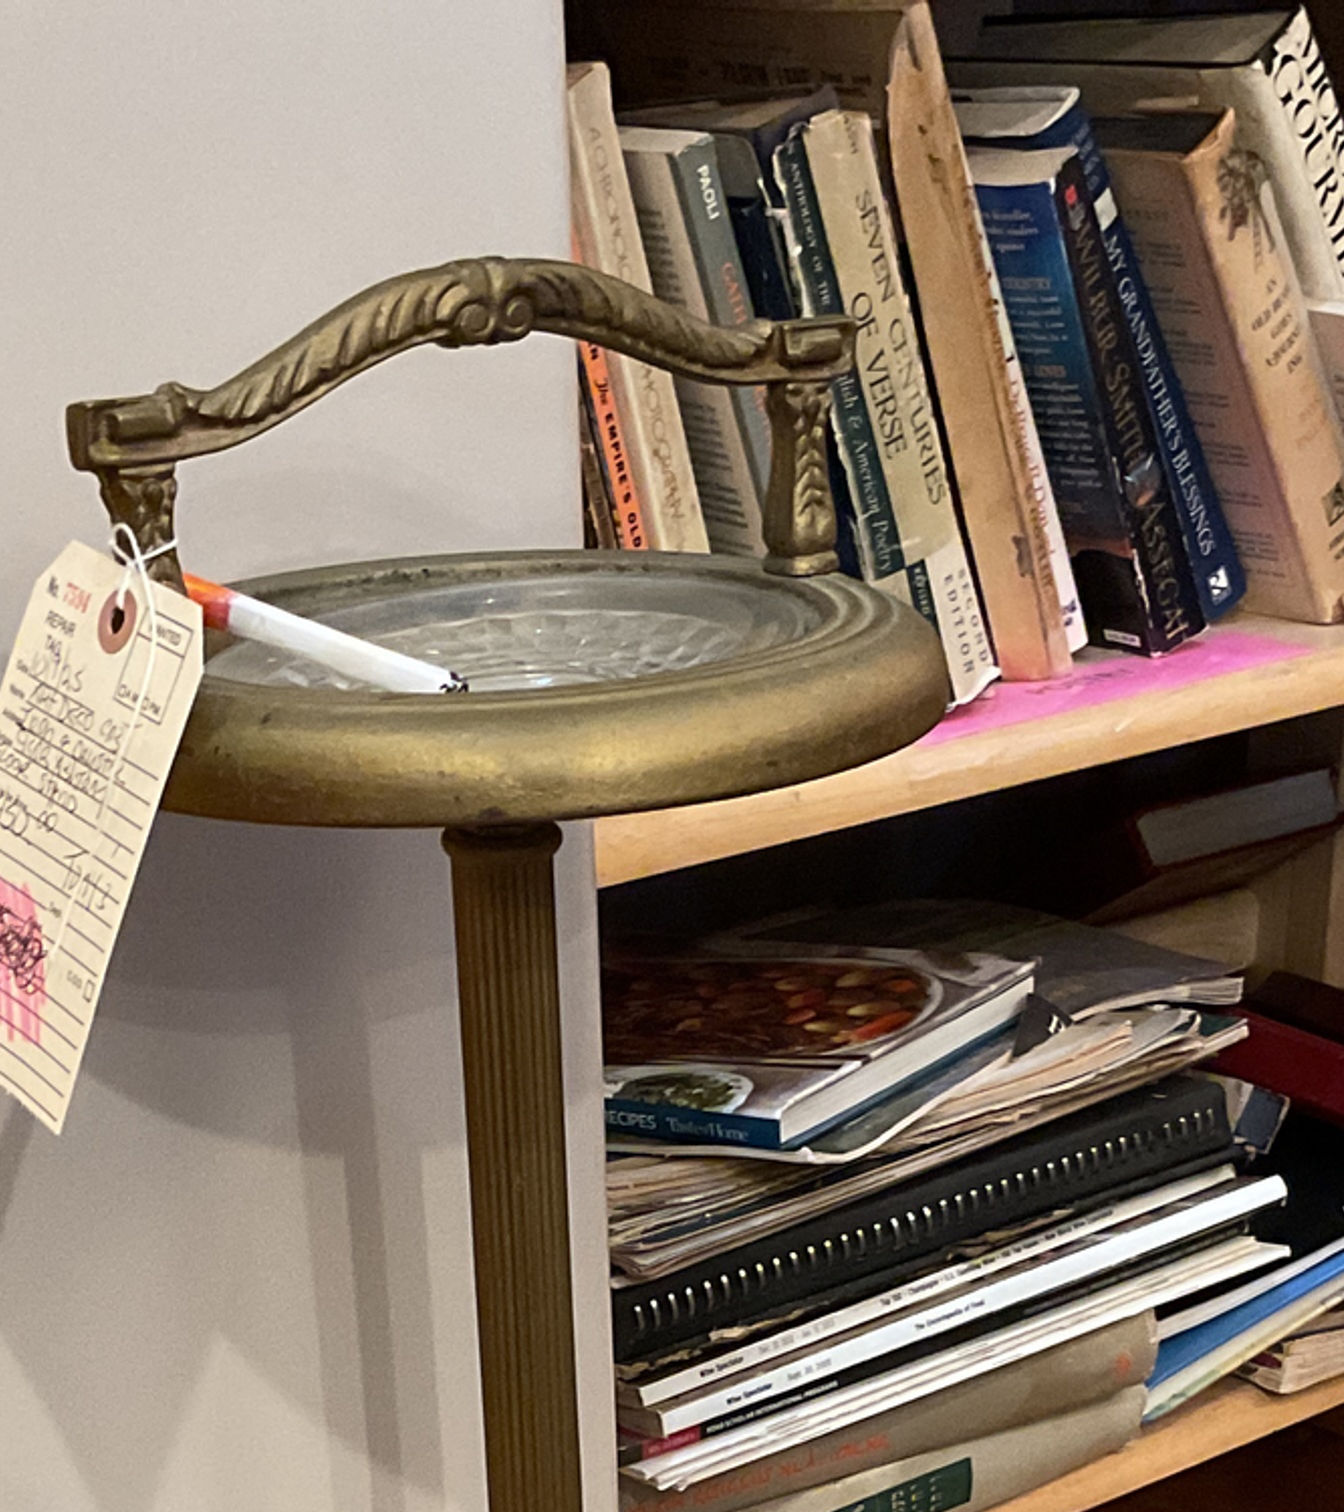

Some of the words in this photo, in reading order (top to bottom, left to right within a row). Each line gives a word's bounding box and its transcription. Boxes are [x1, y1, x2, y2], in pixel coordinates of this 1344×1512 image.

[696, 164, 721, 222] PAOLI
[856, 190, 896, 304] SEVEN
[887, 317, 948, 507] CENTURIES
[1075, 222, 1118, 363] WILBUR
[850, 292, 880, 341] OF
[865, 348, 908, 461] VERSE
[1105, 235, 1127, 272] MY
[1117, 276, 1184, 451] GRANDFATHER'S
[1171, 448, 1218, 557] BLESSINGS
[604, 412, 631, 505] EMPIRE'S
[626, 512, 644, 550] OLD
[852, 440, 883, 520] American
[871, 519, 901, 573] Poetry
[44, 609, 77, 638] REPAIR
[944, 573, 976, 674] EDITION
[958, 568, 988, 663] SECOND
